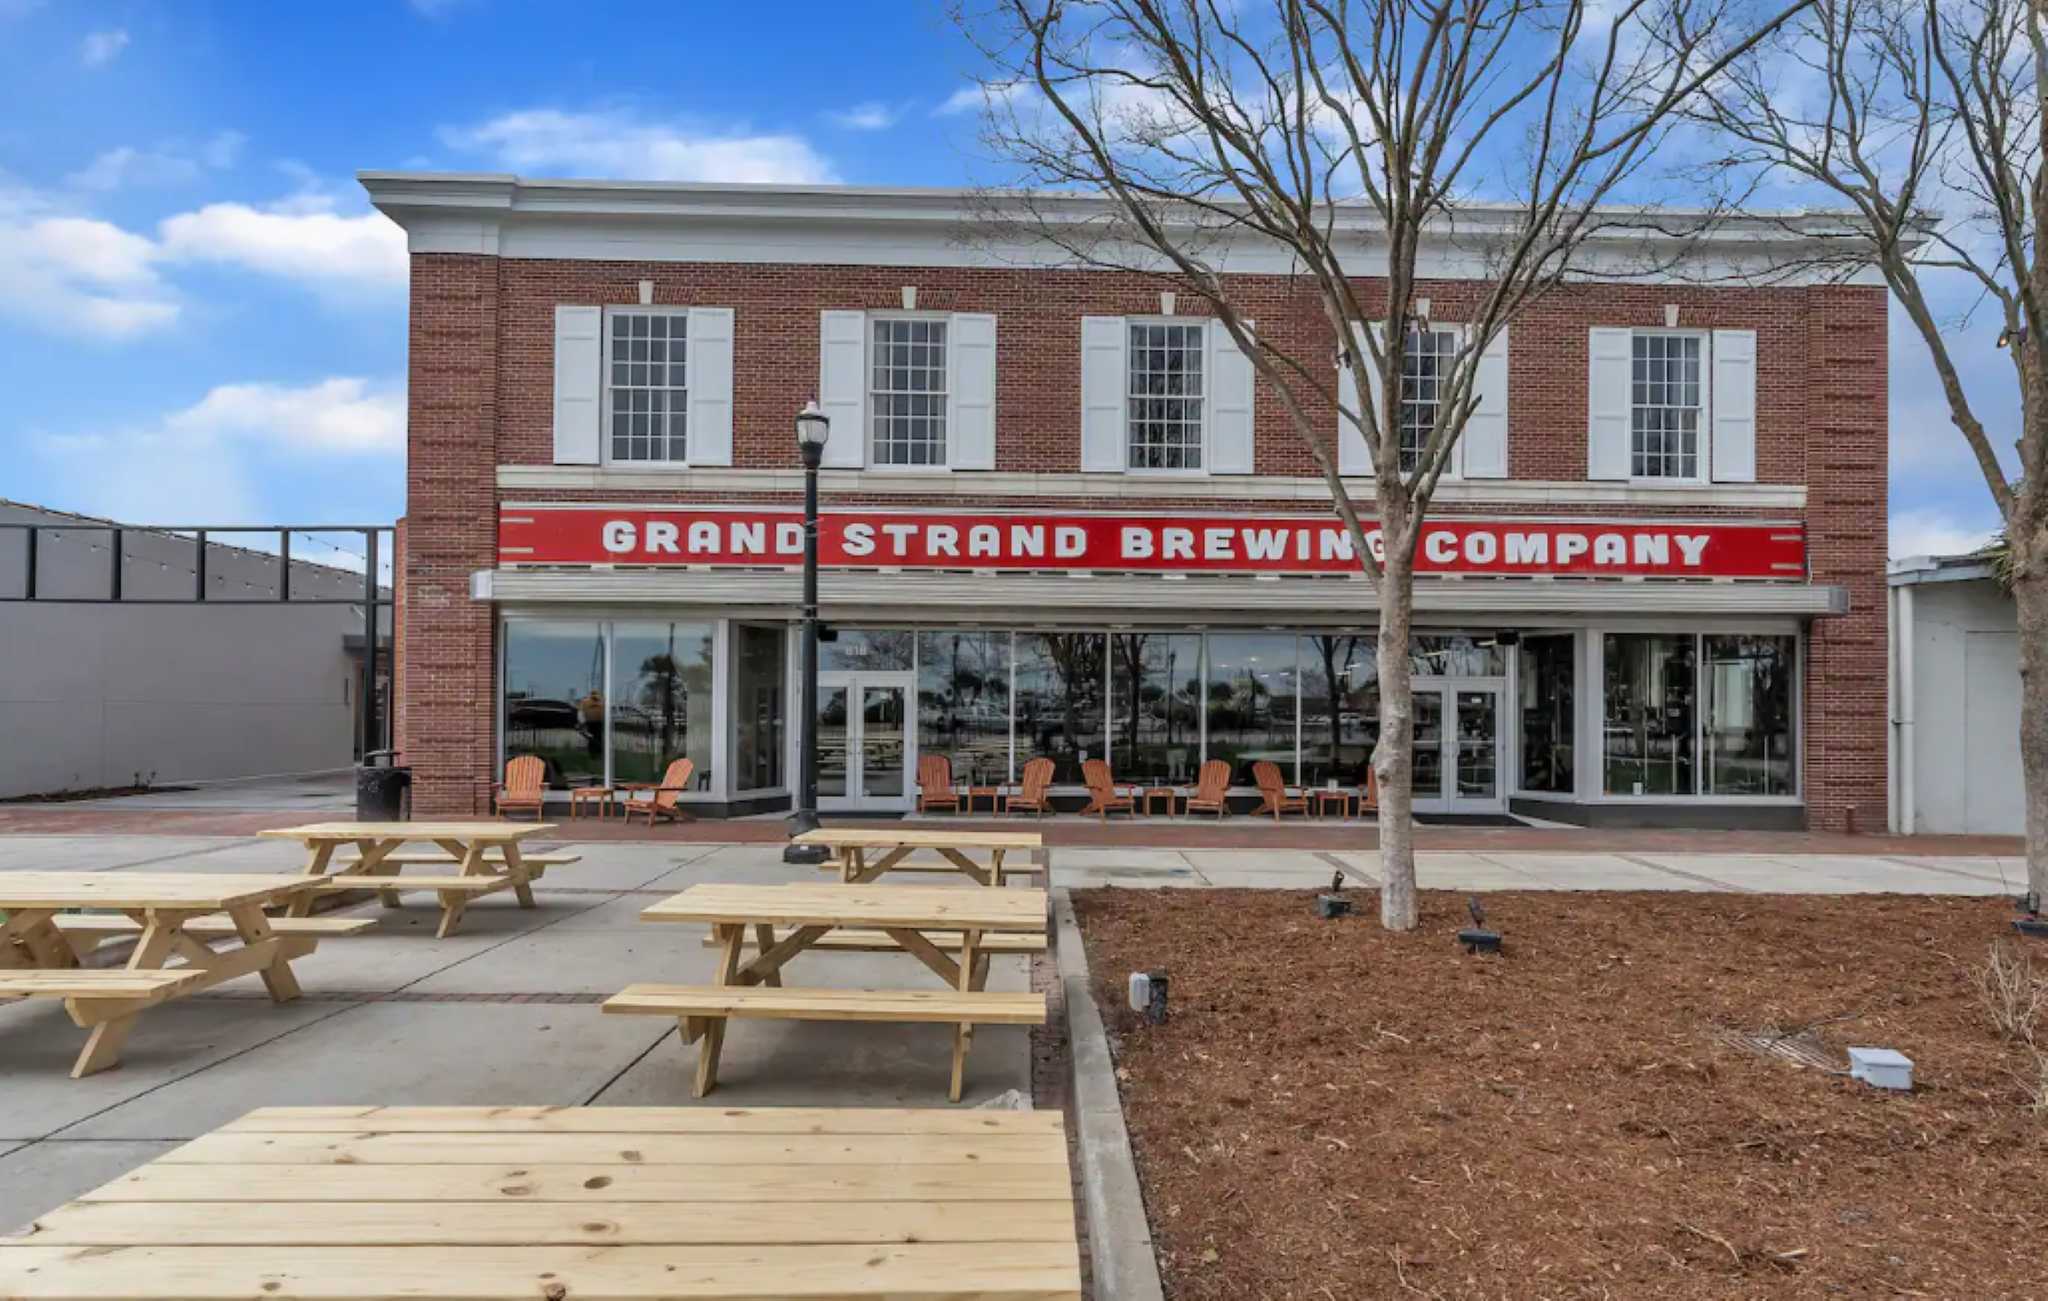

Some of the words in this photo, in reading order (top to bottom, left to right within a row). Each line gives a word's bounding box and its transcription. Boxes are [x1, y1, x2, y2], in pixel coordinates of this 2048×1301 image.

[602, 520, 805, 554] GRAND
[841, 522, 1087, 557] STRAND
[1425, 530, 1710, 566] COMPANY
